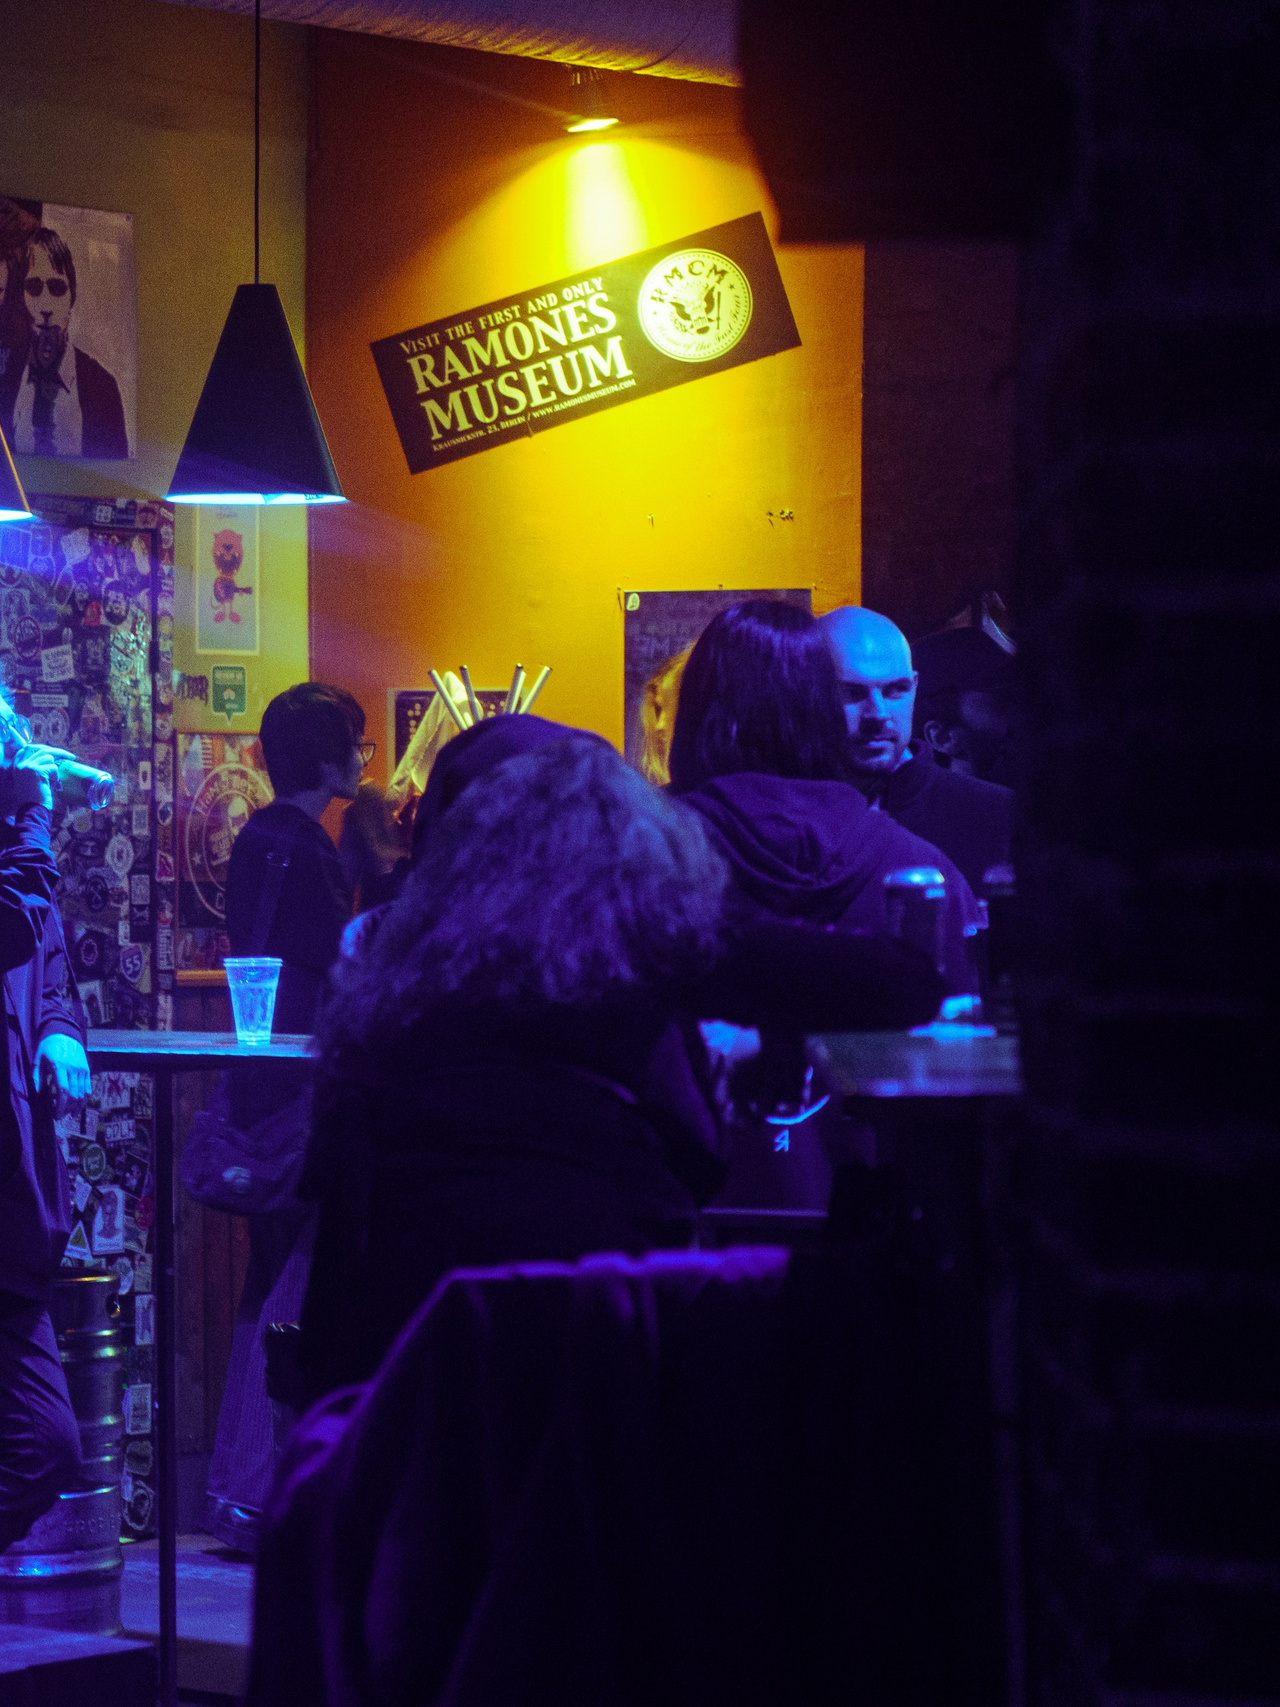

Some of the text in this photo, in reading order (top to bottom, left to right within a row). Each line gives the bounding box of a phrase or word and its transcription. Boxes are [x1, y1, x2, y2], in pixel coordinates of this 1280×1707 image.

[400, 277, 603, 354] VISIT THE FIRST AND ONLY
[650, 260, 729, 304] RMCM
[407, 293, 618, 394] RAMONES
[420, 336, 633, 442] MUSEUM
[124, 953, 141, 974] 55
